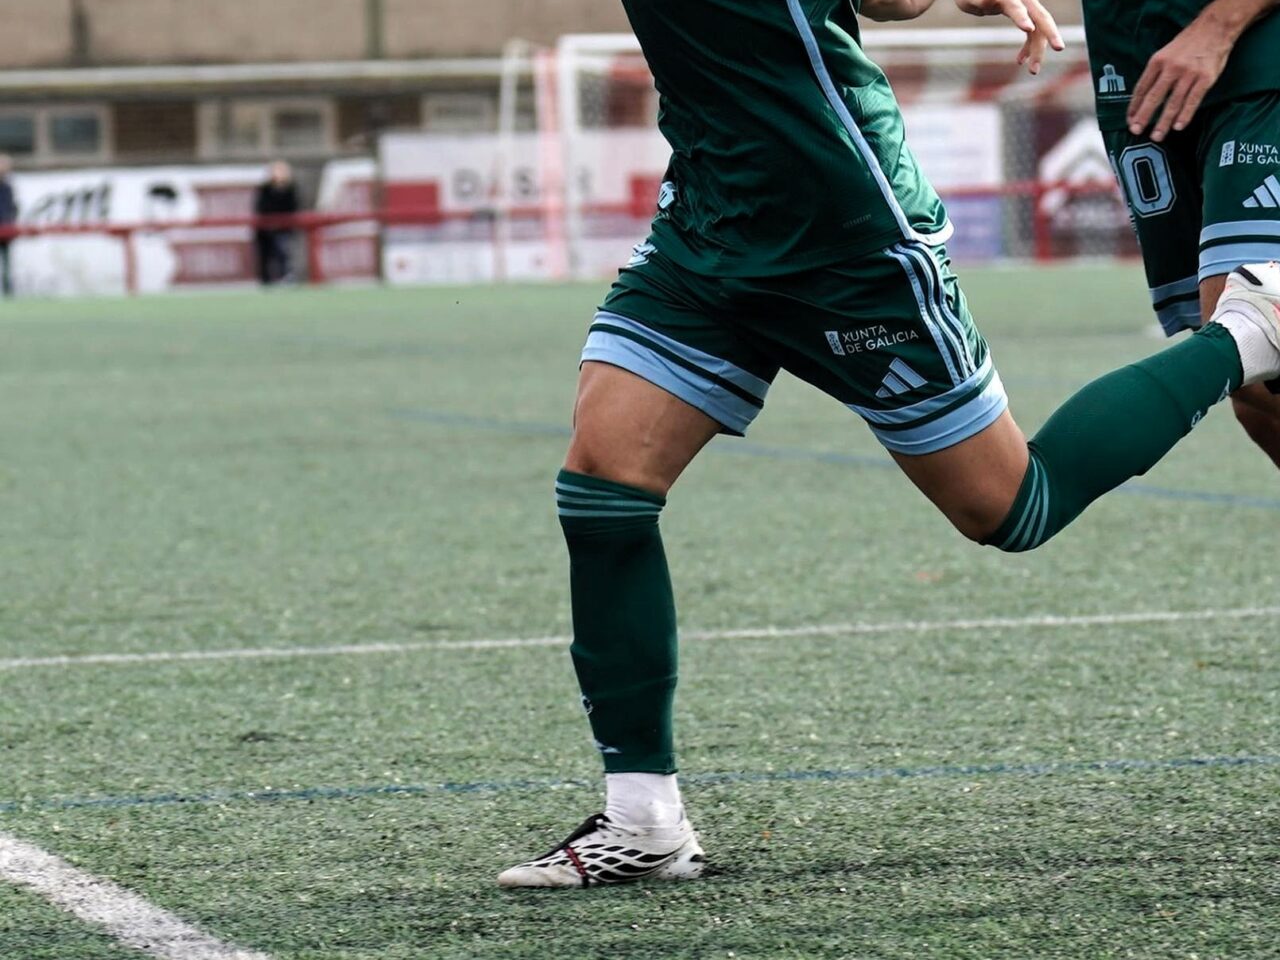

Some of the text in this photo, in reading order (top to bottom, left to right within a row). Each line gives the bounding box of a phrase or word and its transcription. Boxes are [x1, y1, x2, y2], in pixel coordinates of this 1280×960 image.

[1239, 142, 1279, 155] XUNTA
[1237, 153, 1254, 164] DE
[841, 325, 888, 344] XUNTA
[845, 329, 919, 354] DE GALICIA
